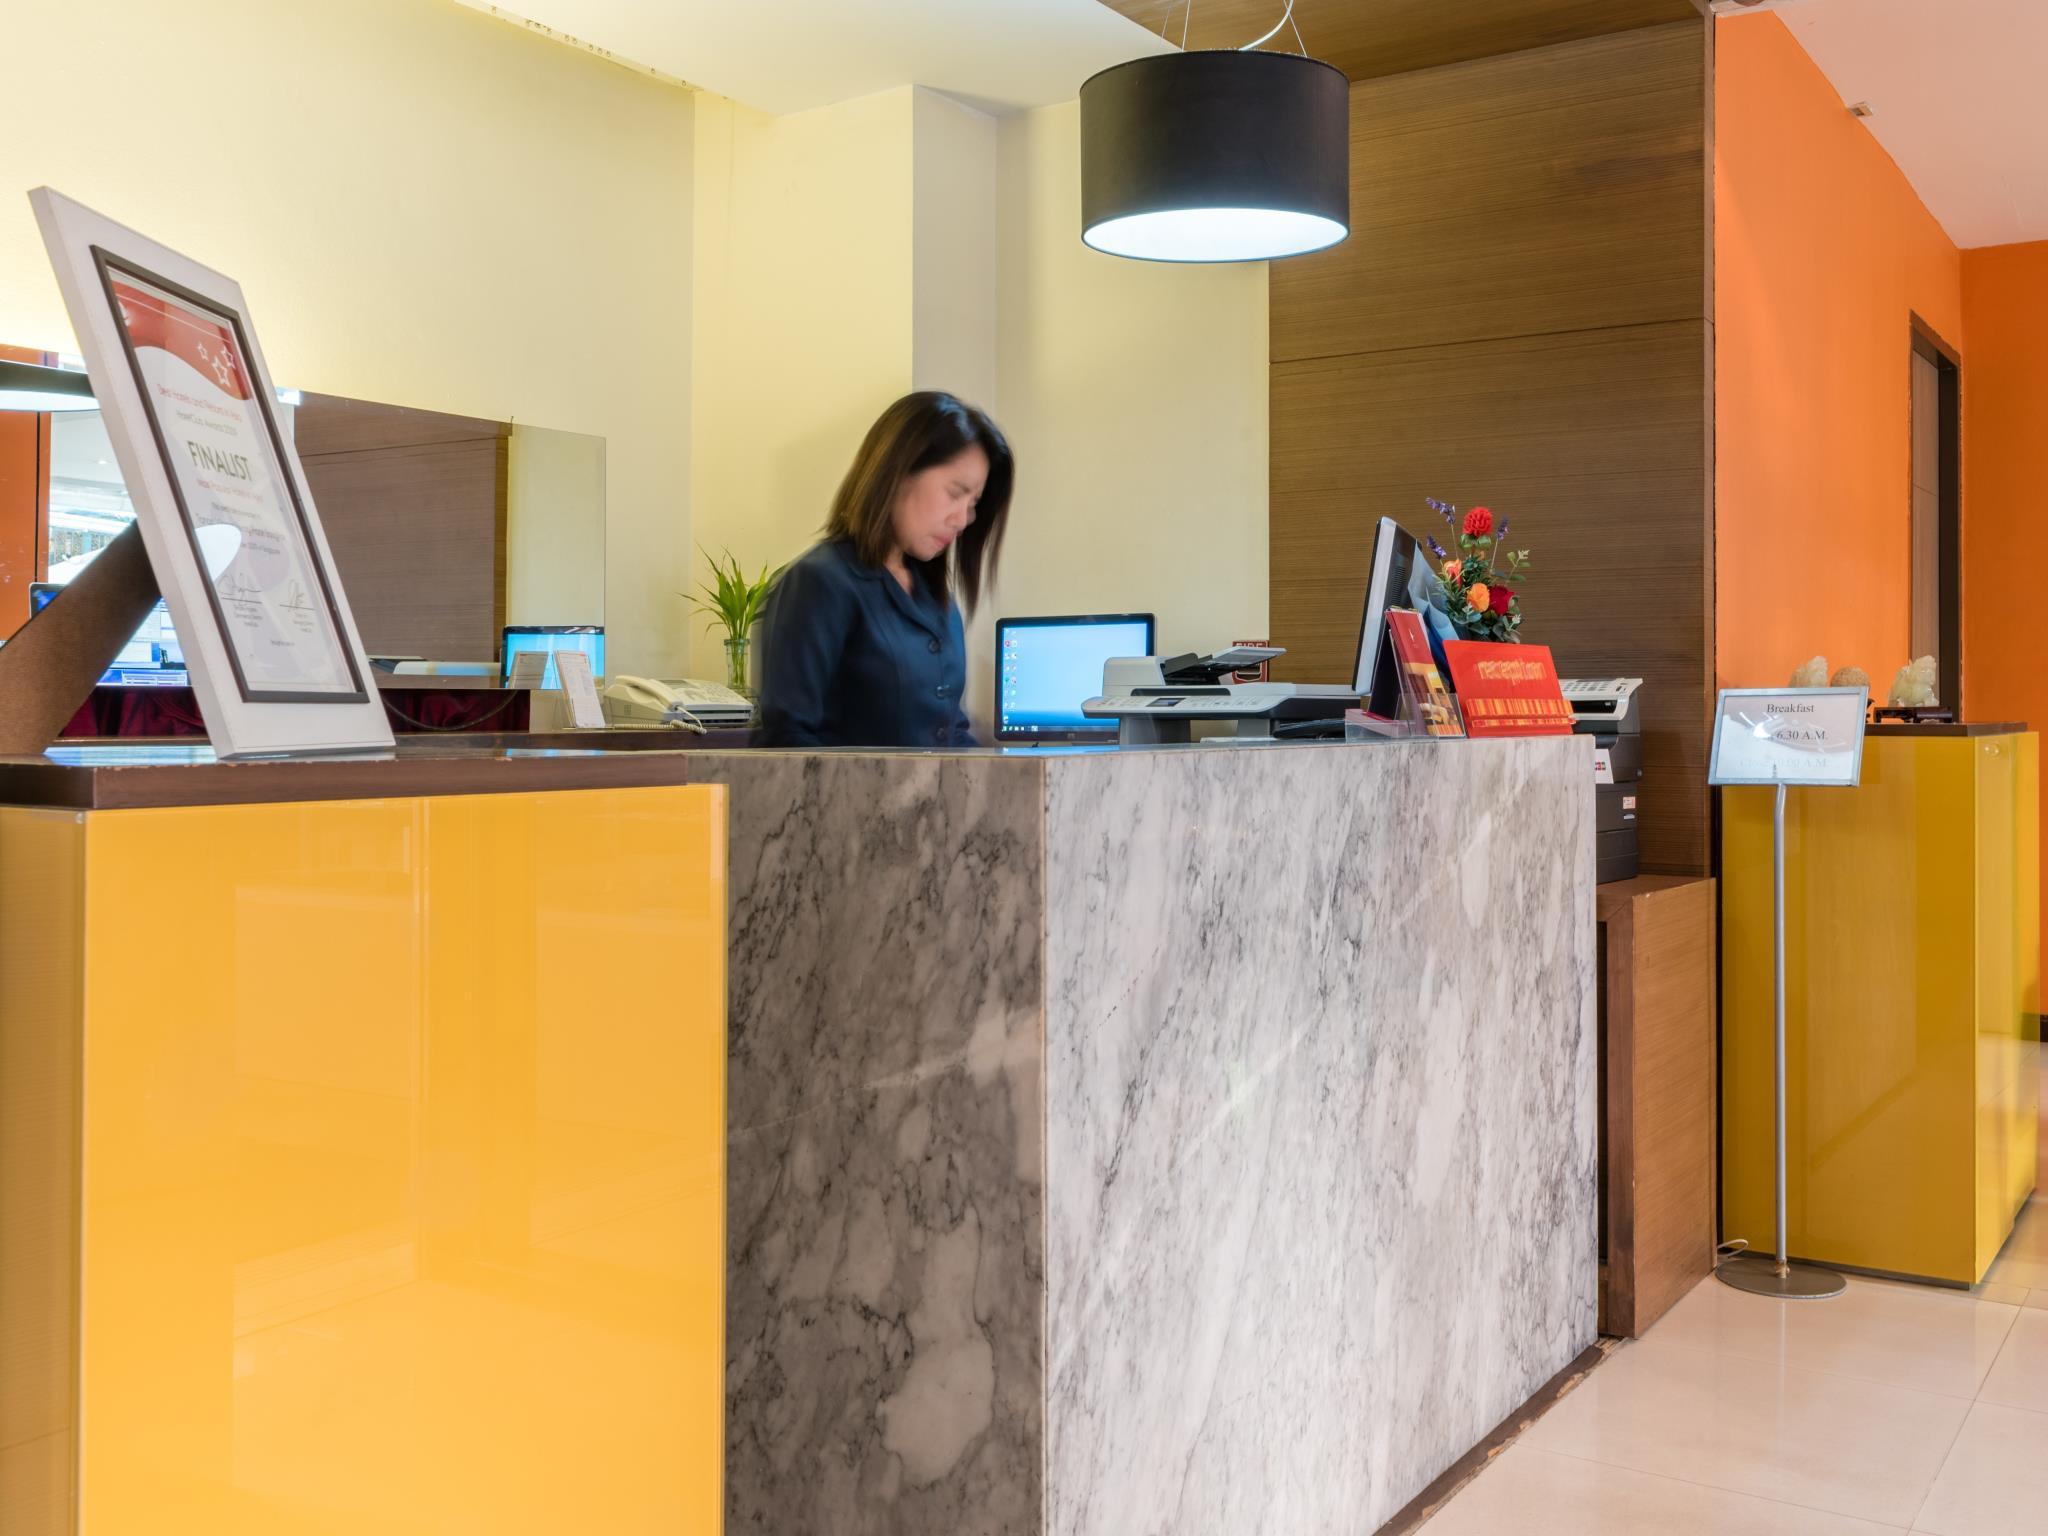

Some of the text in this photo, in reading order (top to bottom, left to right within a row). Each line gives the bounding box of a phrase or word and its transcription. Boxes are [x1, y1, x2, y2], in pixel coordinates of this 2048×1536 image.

[187, 440, 252, 482] FINALIST
[1476, 658, 1547, 685] reception
[1767, 703, 1815, 713] Breakfast
[1776, 730, 1828, 740] 6.30 A.M.
